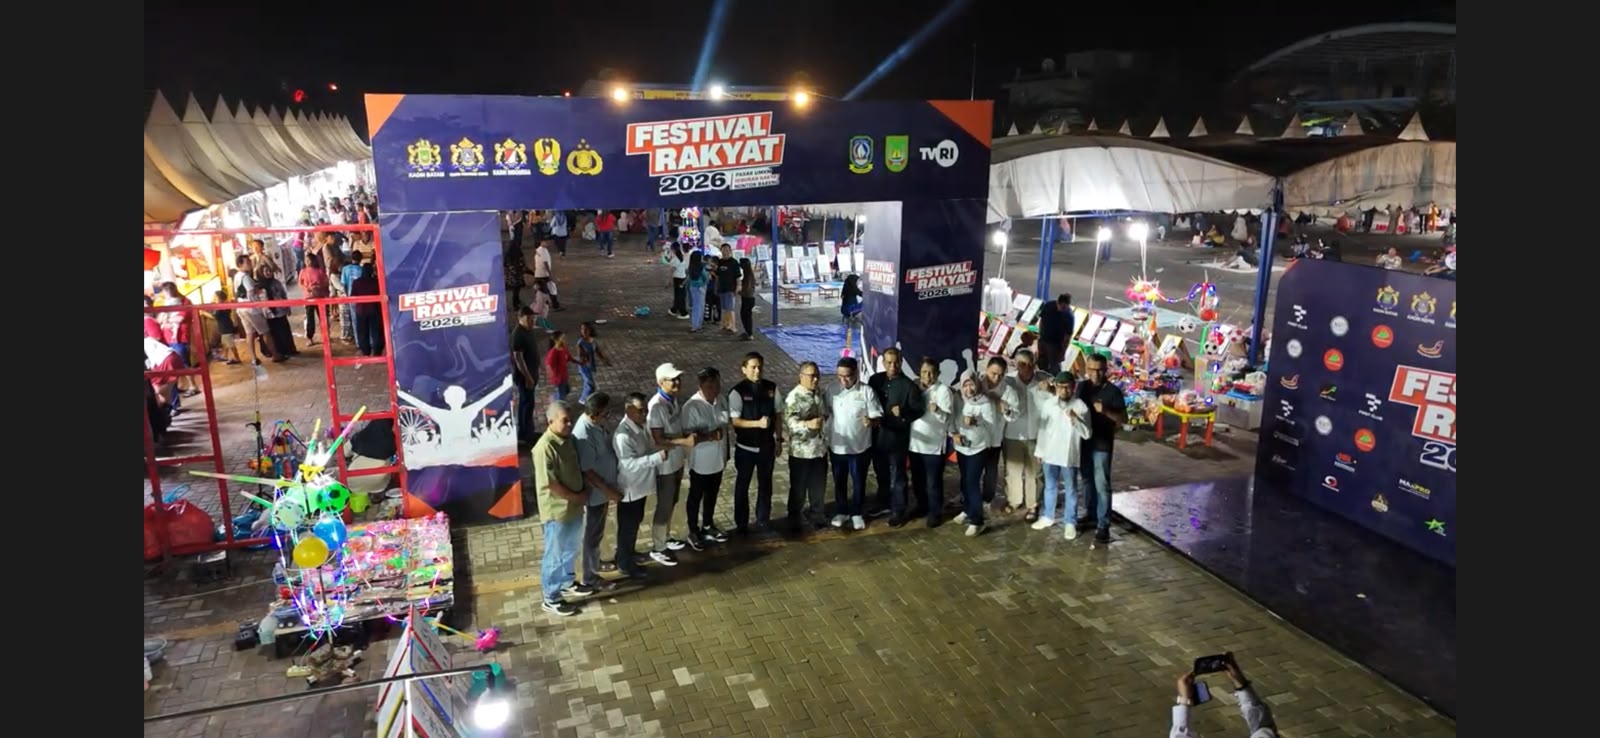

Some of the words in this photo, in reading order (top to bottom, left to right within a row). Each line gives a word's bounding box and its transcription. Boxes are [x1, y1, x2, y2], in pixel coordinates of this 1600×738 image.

[635, 115, 766, 148] FESTIVAL
[655, 137, 780, 172] RAKYAT
[660, 172, 727, 193] 2026
[866, 261, 893, 273] FESTIVAL
[909, 262, 969, 280] FESTIVAL
[869, 272, 896, 285] RAKYAT
[917, 271, 974, 290] RAKYAT
[403, 285, 486, 307] FESTIVAL
[919, 288, 950, 300] 2026
[416, 297, 495, 319] RAKYAT
[421, 317, 462, 329] 2026
